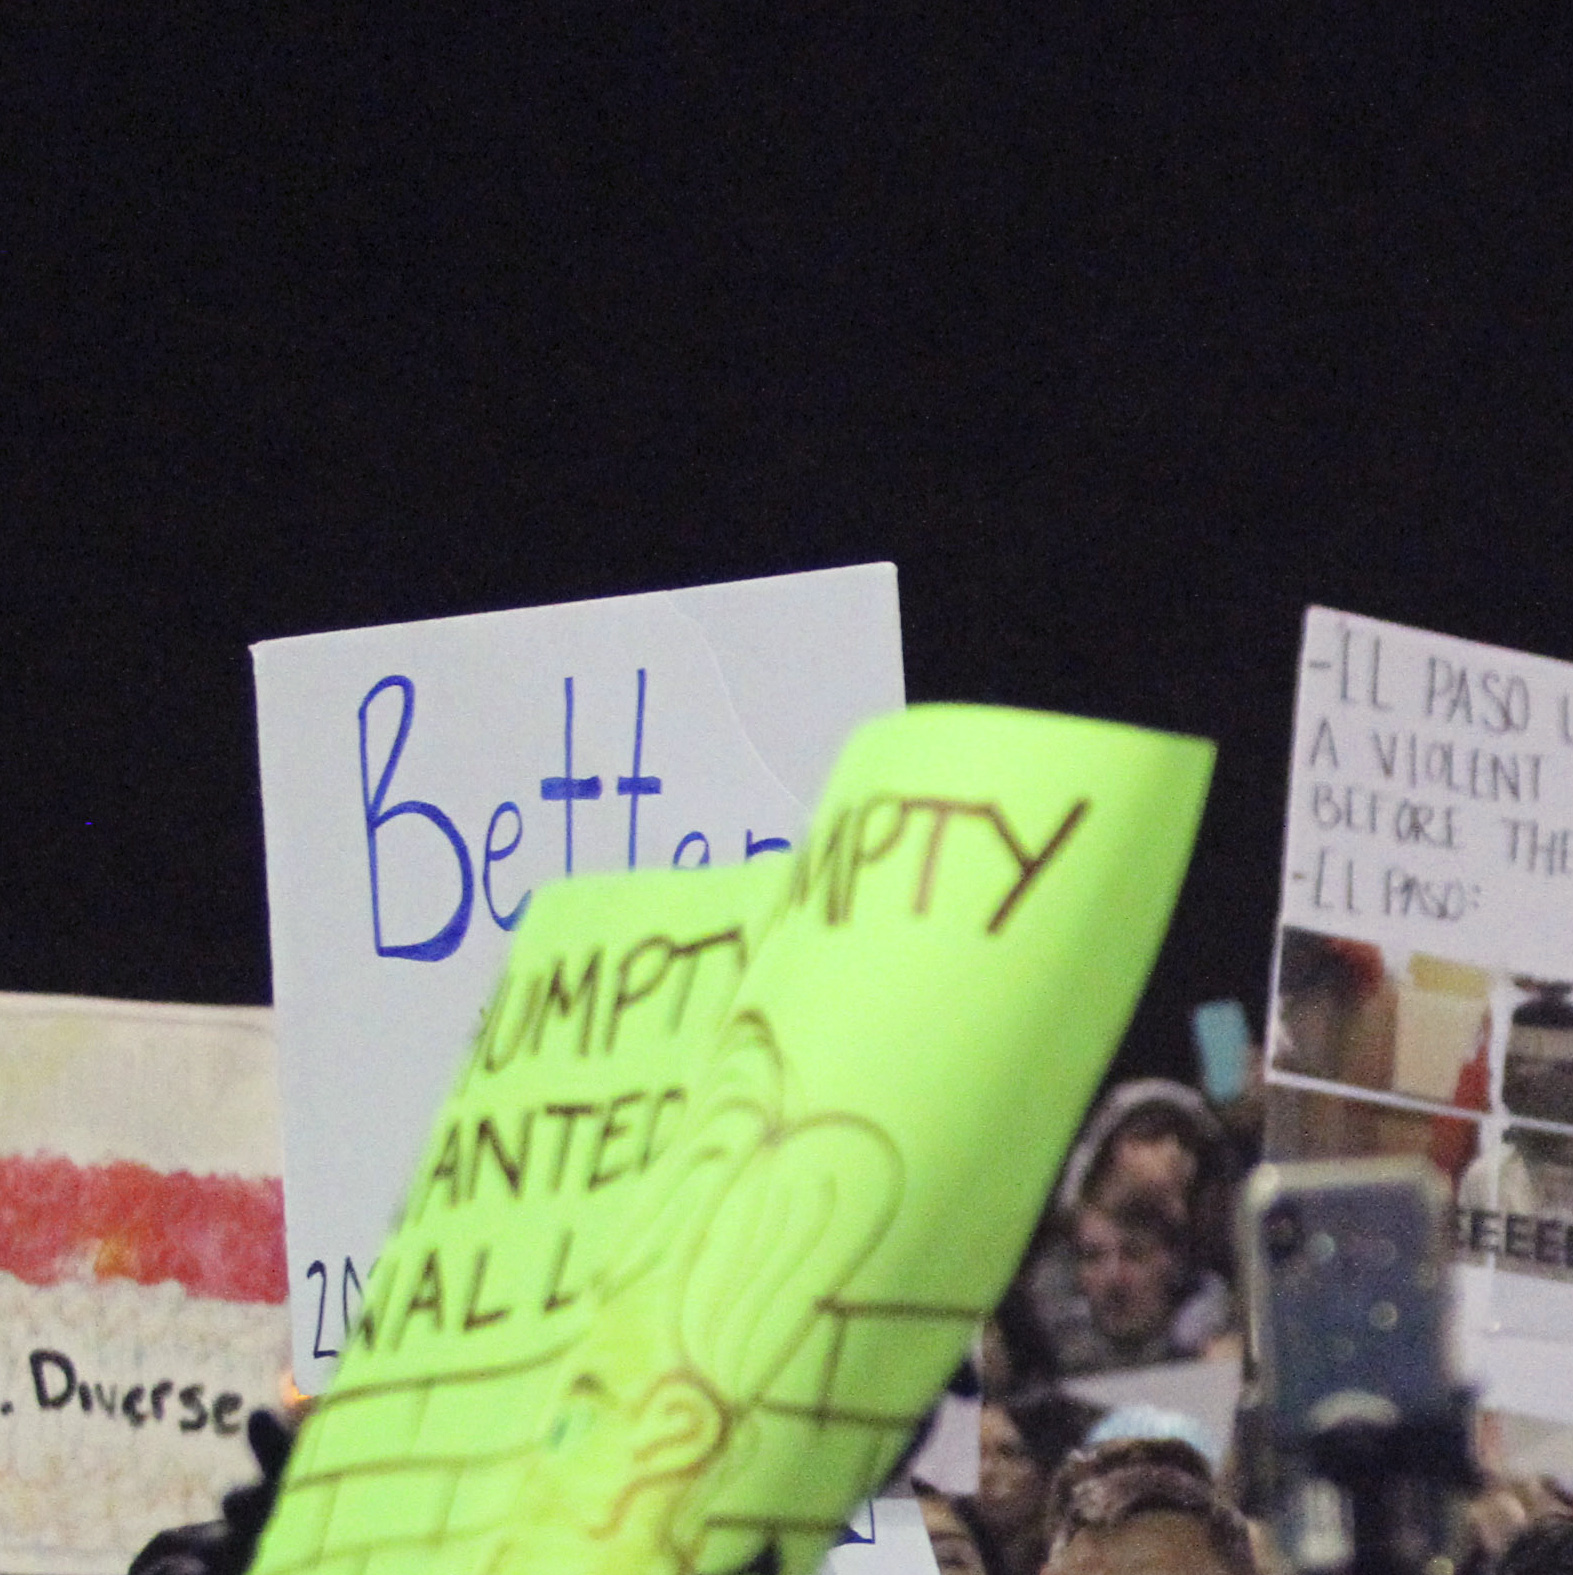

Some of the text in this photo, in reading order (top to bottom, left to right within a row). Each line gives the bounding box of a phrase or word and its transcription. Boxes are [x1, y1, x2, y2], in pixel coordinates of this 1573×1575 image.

[1427, 656, 1532, 734] PASO
[1308, 717, 1342, 770] A
[358, 667, 792, 962] Bett
[1310, 785, 1461, 850] BEFORE
[28, 1348, 244, 1436] Diverse
